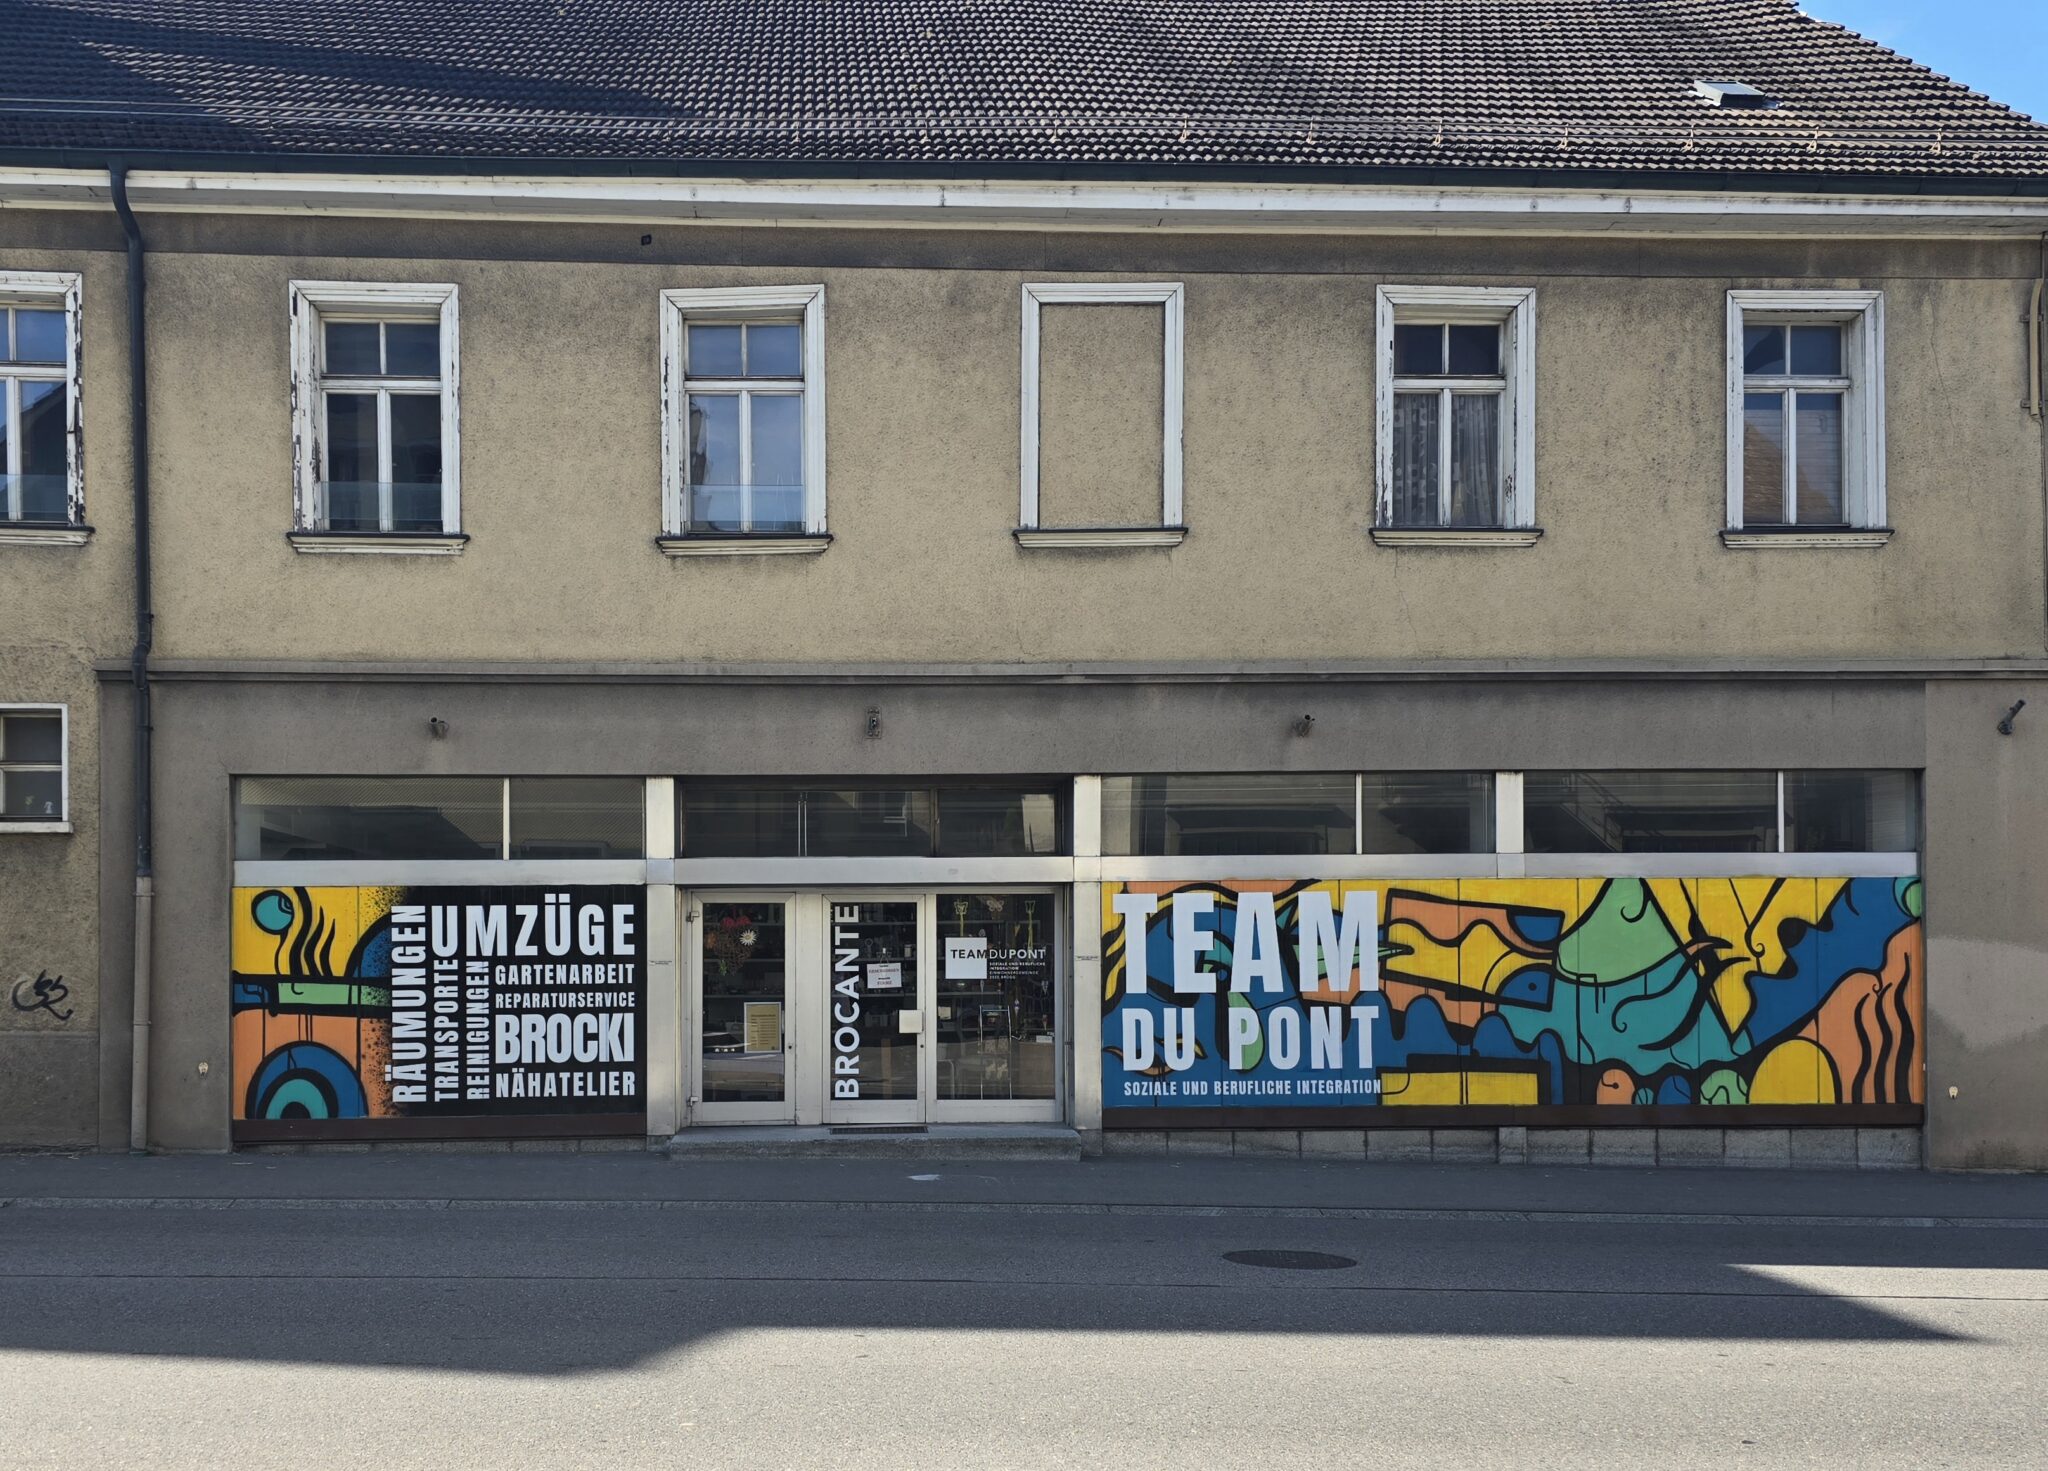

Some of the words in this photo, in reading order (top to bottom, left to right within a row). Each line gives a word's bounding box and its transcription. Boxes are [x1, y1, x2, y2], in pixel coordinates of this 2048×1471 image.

[431, 893, 635, 957] UMZÜGE
[1113, 891, 1379, 994] TEAM
[385, 905, 426, 1102] RÄUMUNGEN
[495, 964, 635, 985] GARTENARBEIT
[495, 992, 635, 1009] REPARATURSERVICE
[834, 905, 860, 1098] BROCANTE
[434, 959, 459, 1102] TRANSPORTE
[466, 960, 490, 1100] REINIGUNGEN
[495, 1013, 635, 1064] BROCKI
[1122, 1007, 1195, 1071] DU
[1228, 1005, 1379, 1071] PONT
[496, 1068, 635, 1098] NÄHATELIER
[1124, 1081, 1177, 1096] SOZIALE
[1182, 1081, 1208, 1096] UND
[1214, 1080, 1292, 1095] BERUFLICHE
[1297, 1079, 1381, 1094] INTEGRATION
